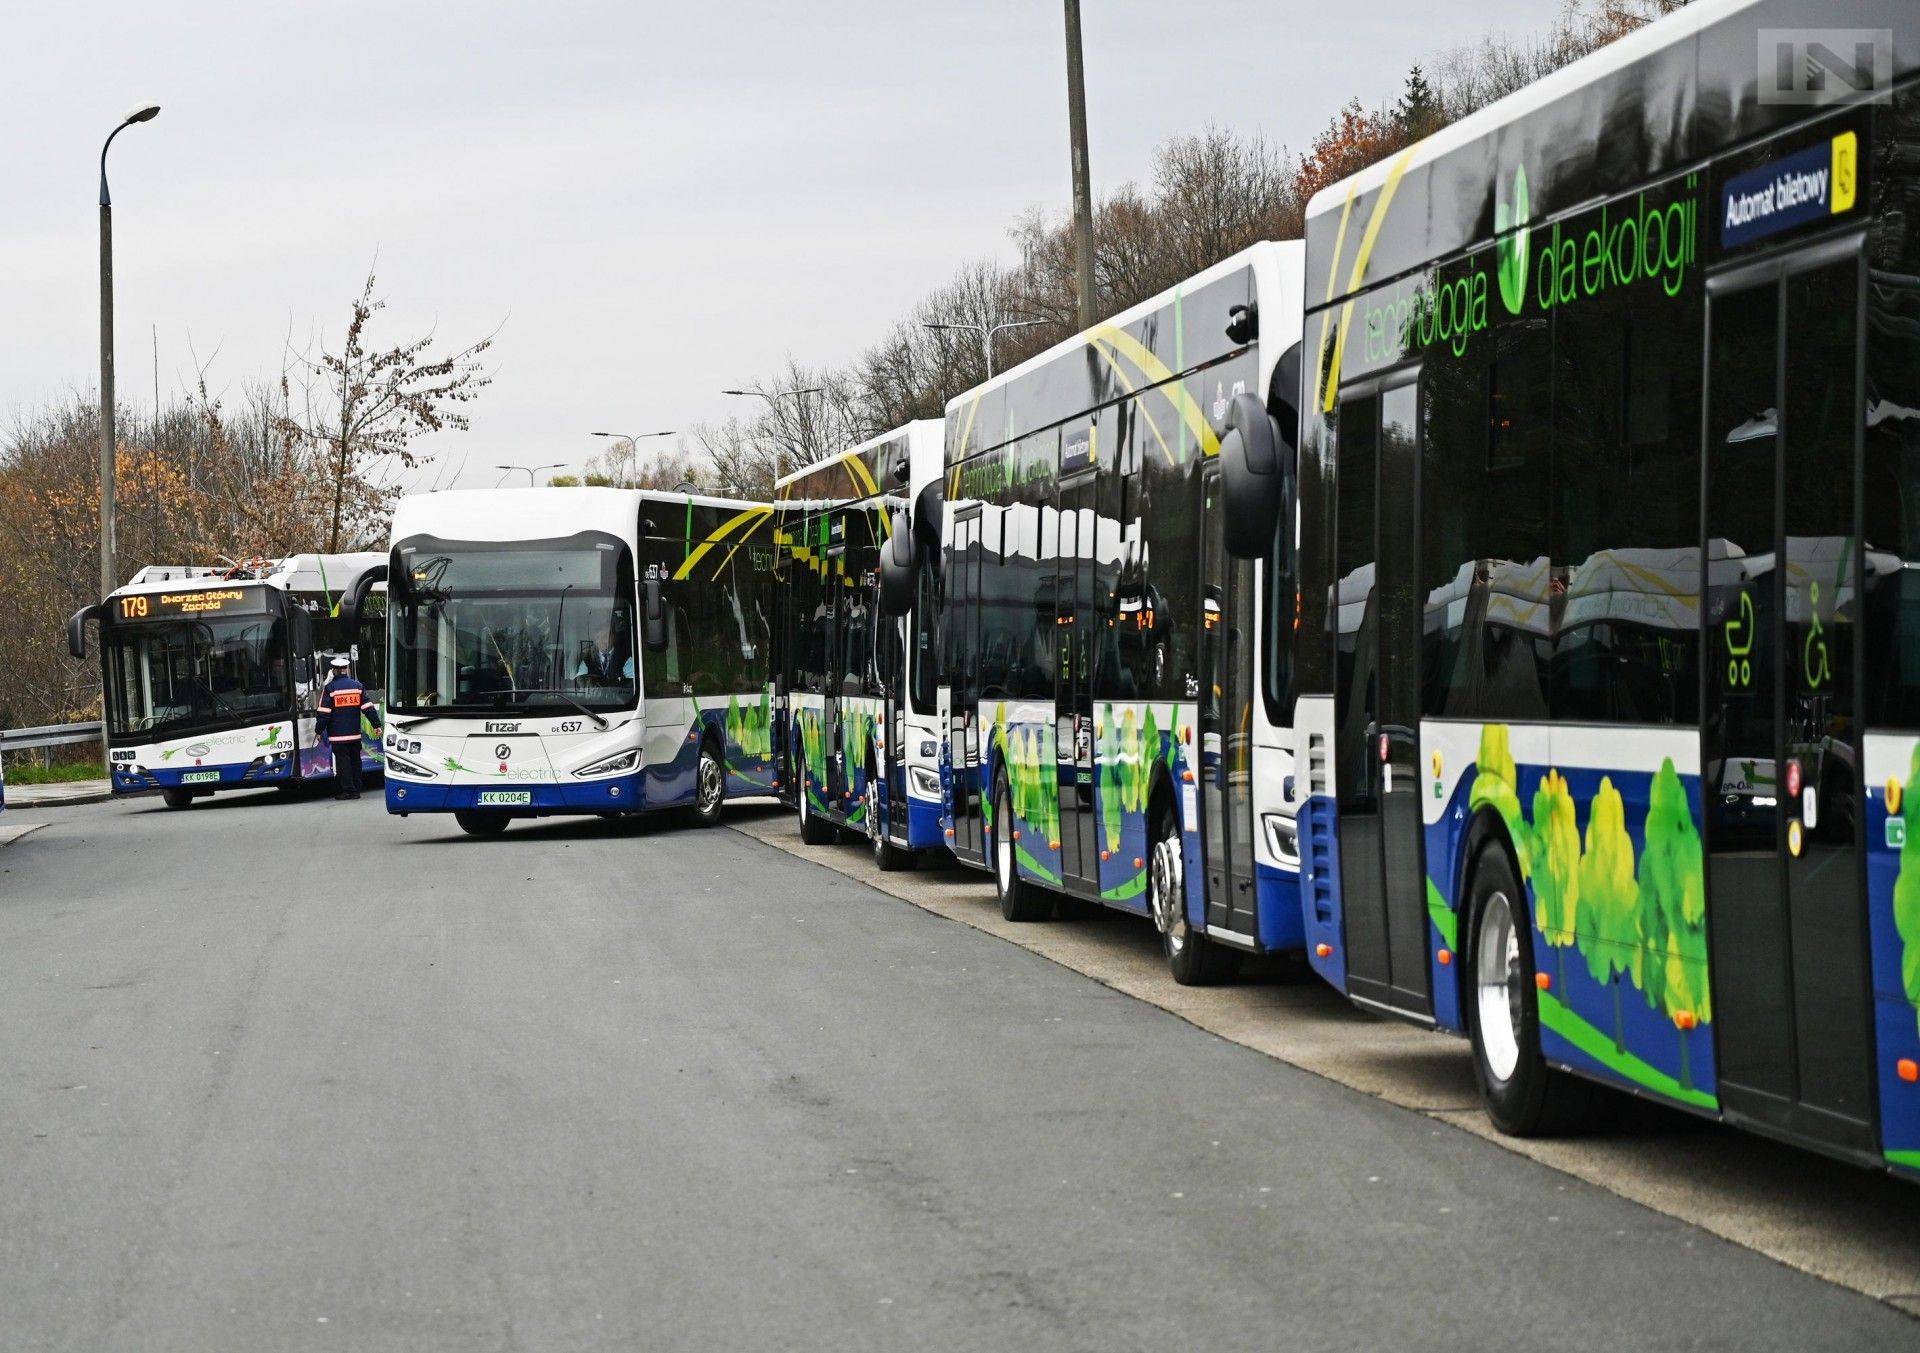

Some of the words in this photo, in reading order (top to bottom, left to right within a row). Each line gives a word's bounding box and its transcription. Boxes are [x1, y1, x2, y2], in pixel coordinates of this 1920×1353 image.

[1725, 181, 1775, 229] Automat
[1776, 167, 1829, 210] biletowy
[1364, 255, 1487, 363] technologia
[1538, 221, 1577, 309] dla
[1583, 171, 1698, 297] ekologii
[161, 594, 205, 604] Dworzec
[206, 590, 243, 601] Główny
[121, 596, 148, 618] 179
[181, 600, 221, 612] Zachód
[561, 721, 583, 733] 637
[205, 735, 246, 747] electric
[277, 740, 293, 750] 079
[184, 772, 195, 782] KK
[507, 765, 562, 780] electric
[483, 792, 496, 803] KK
[498, 792, 529, 803] 0204E
